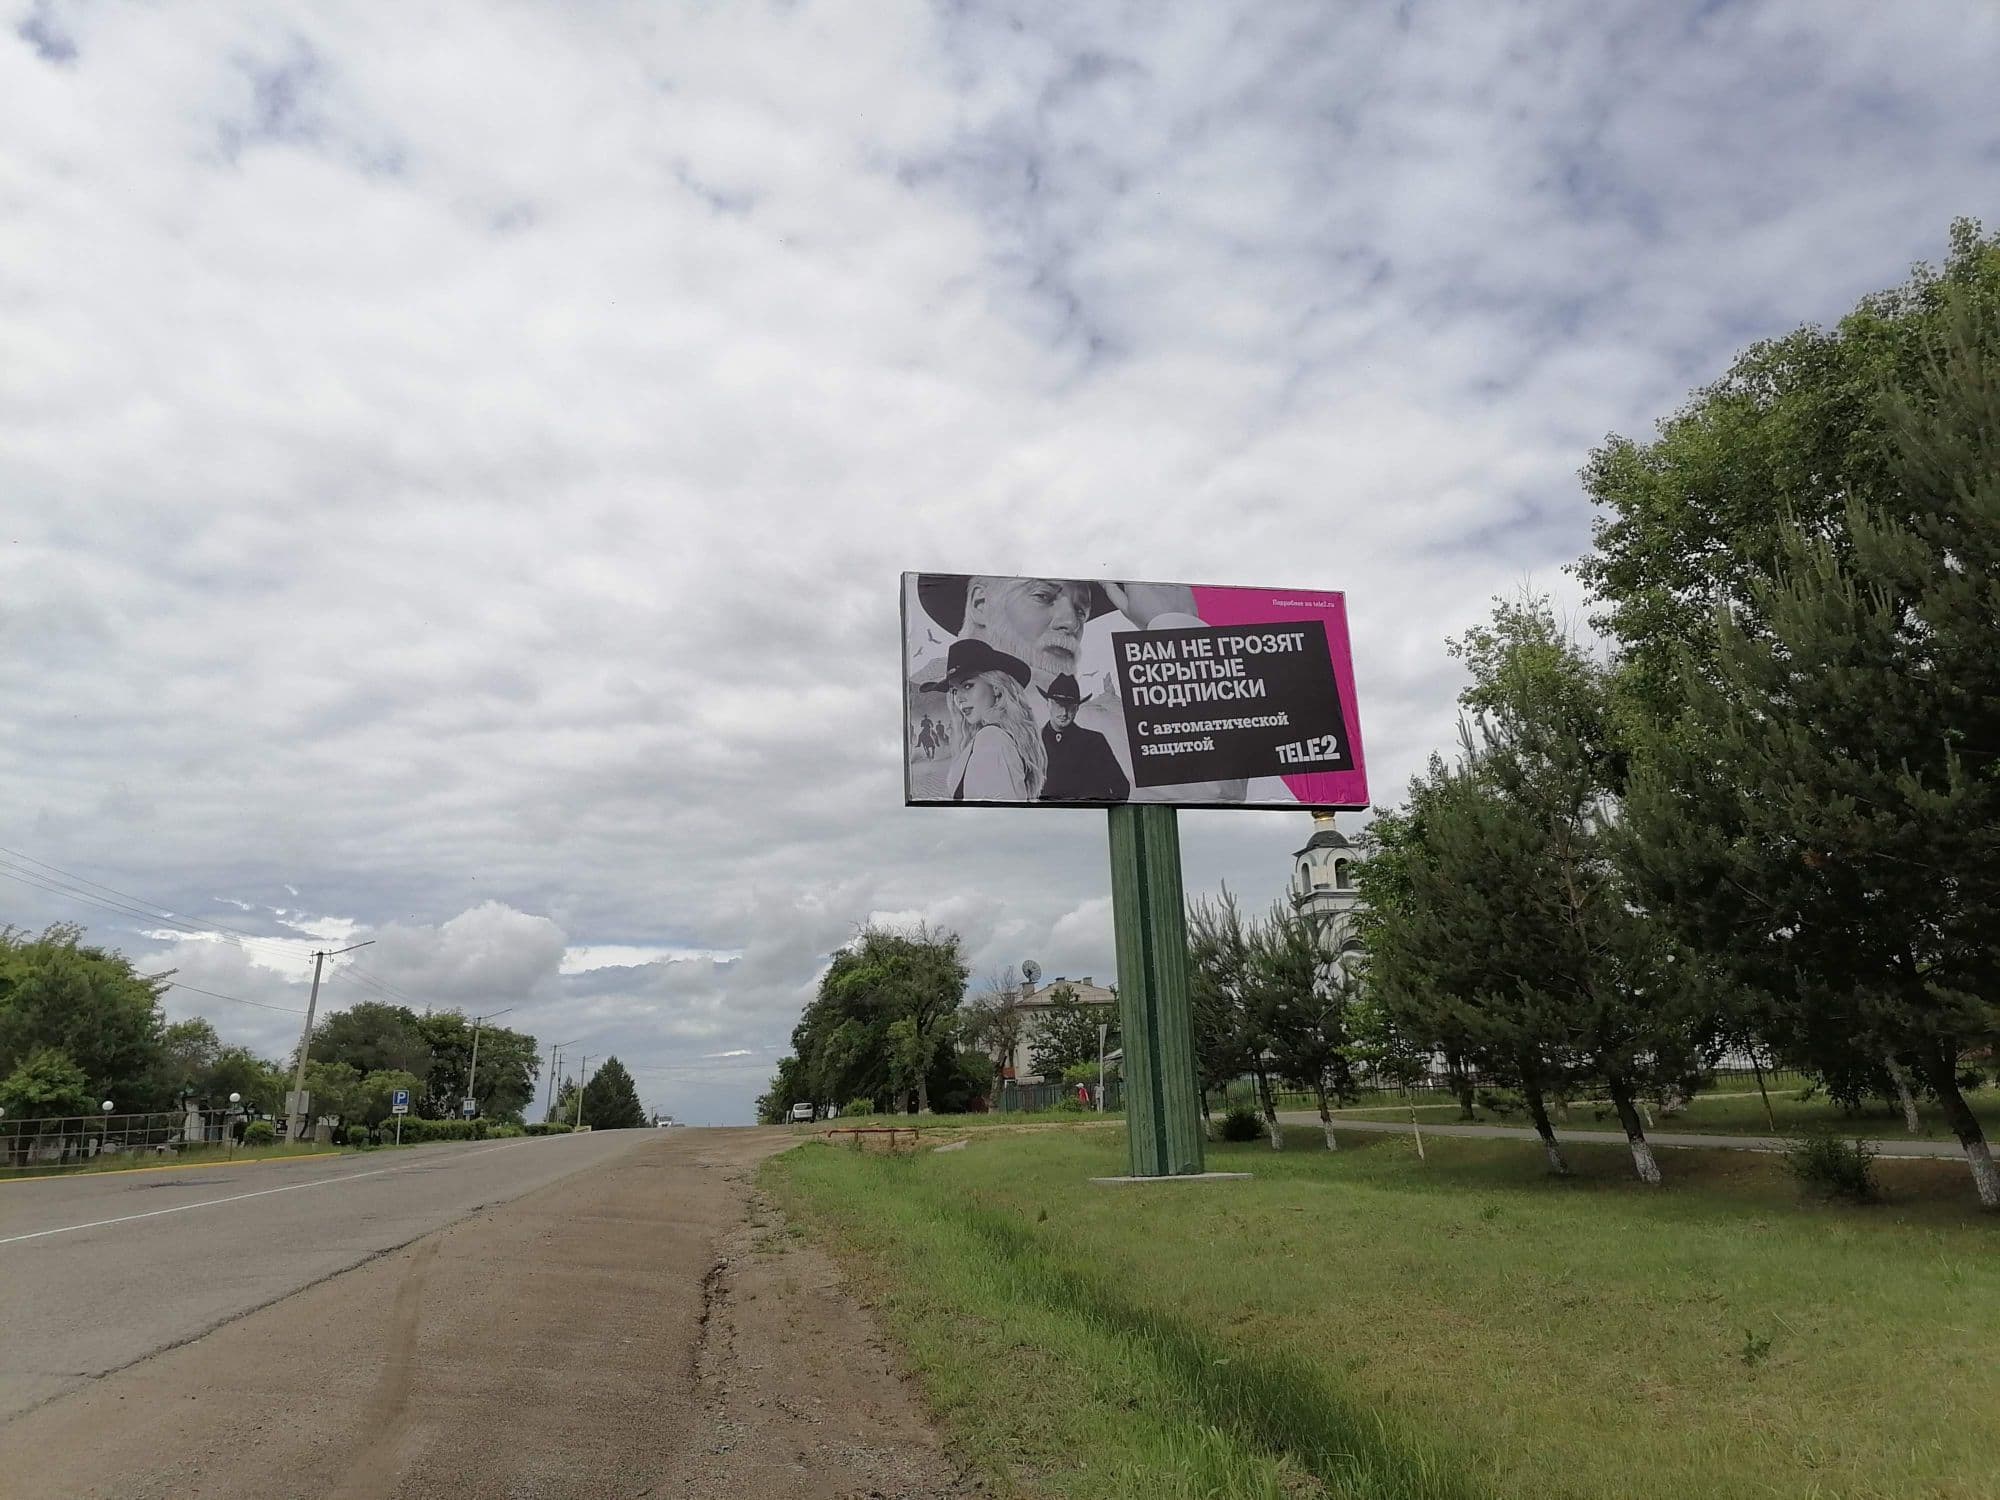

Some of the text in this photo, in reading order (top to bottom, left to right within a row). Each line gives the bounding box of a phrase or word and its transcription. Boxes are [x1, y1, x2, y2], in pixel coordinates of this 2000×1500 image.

[1125, 632, 1305, 662] ВАМ НЕ ГРОЗЯТ
[1128, 658, 1246, 684] СКРЫТЫЕ
[1132, 679, 1266, 708] ПОДПИСКИ
[1137, 712, 1289, 736] С автоматической
[1140, 737, 1215, 756] защитой
[1275, 734, 1341, 764] TELE2
